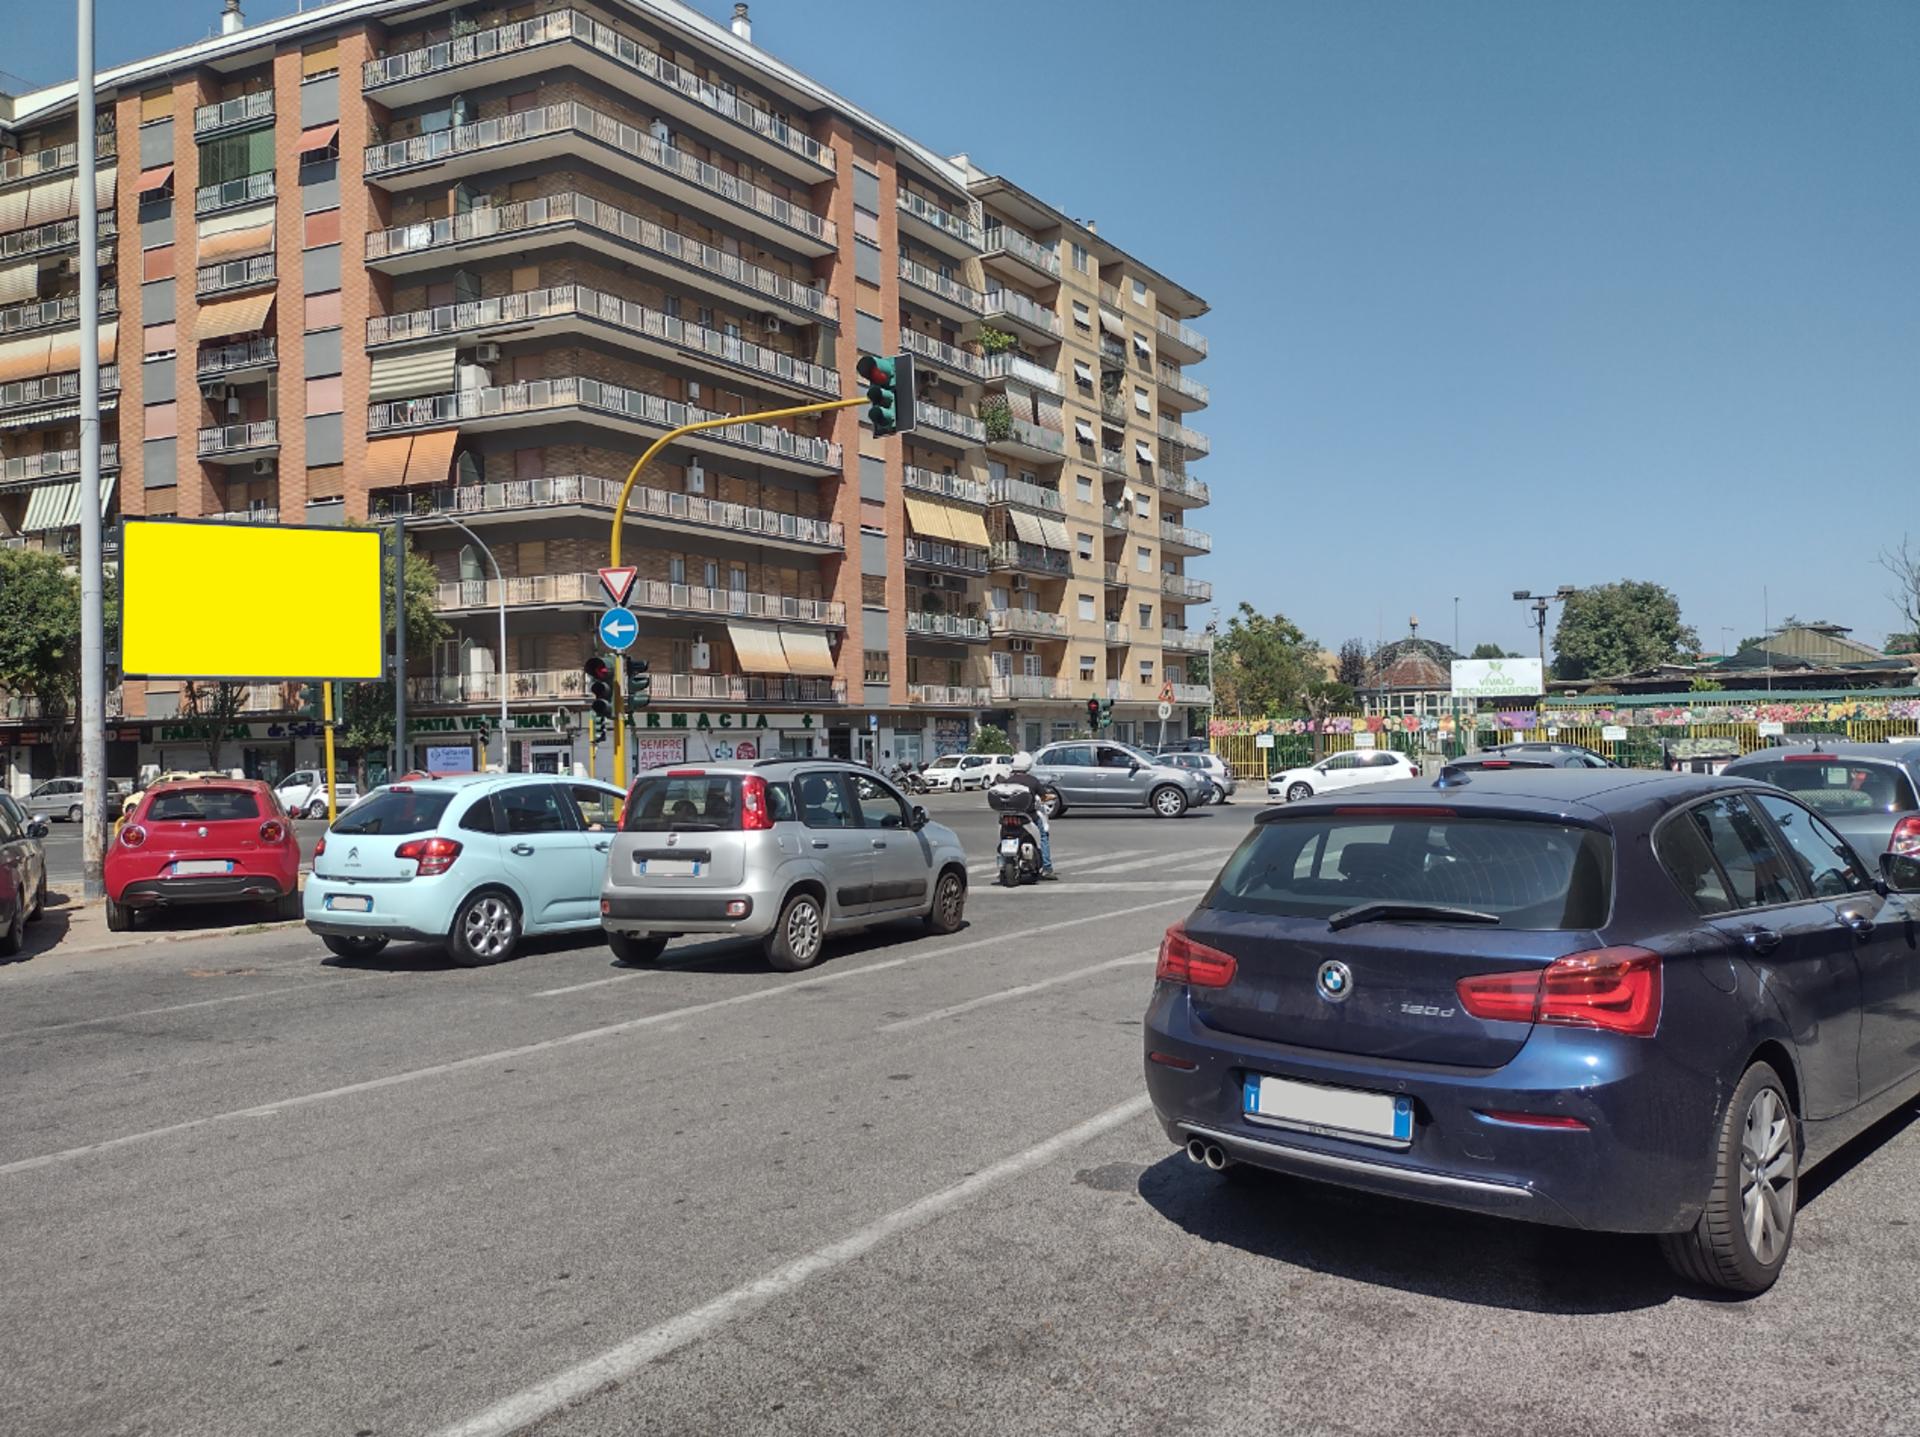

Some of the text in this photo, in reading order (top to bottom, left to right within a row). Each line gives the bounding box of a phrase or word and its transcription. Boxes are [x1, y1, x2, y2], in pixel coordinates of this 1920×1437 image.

[1479, 677, 1515, 687] VIVAIO
[1455, 686, 1539, 697] TECNOGARDEN
[624, 712, 769, 728] ARMACIA
[640, 739, 682, 750] SEMPRE
[640, 750, 682, 761] APERTA
